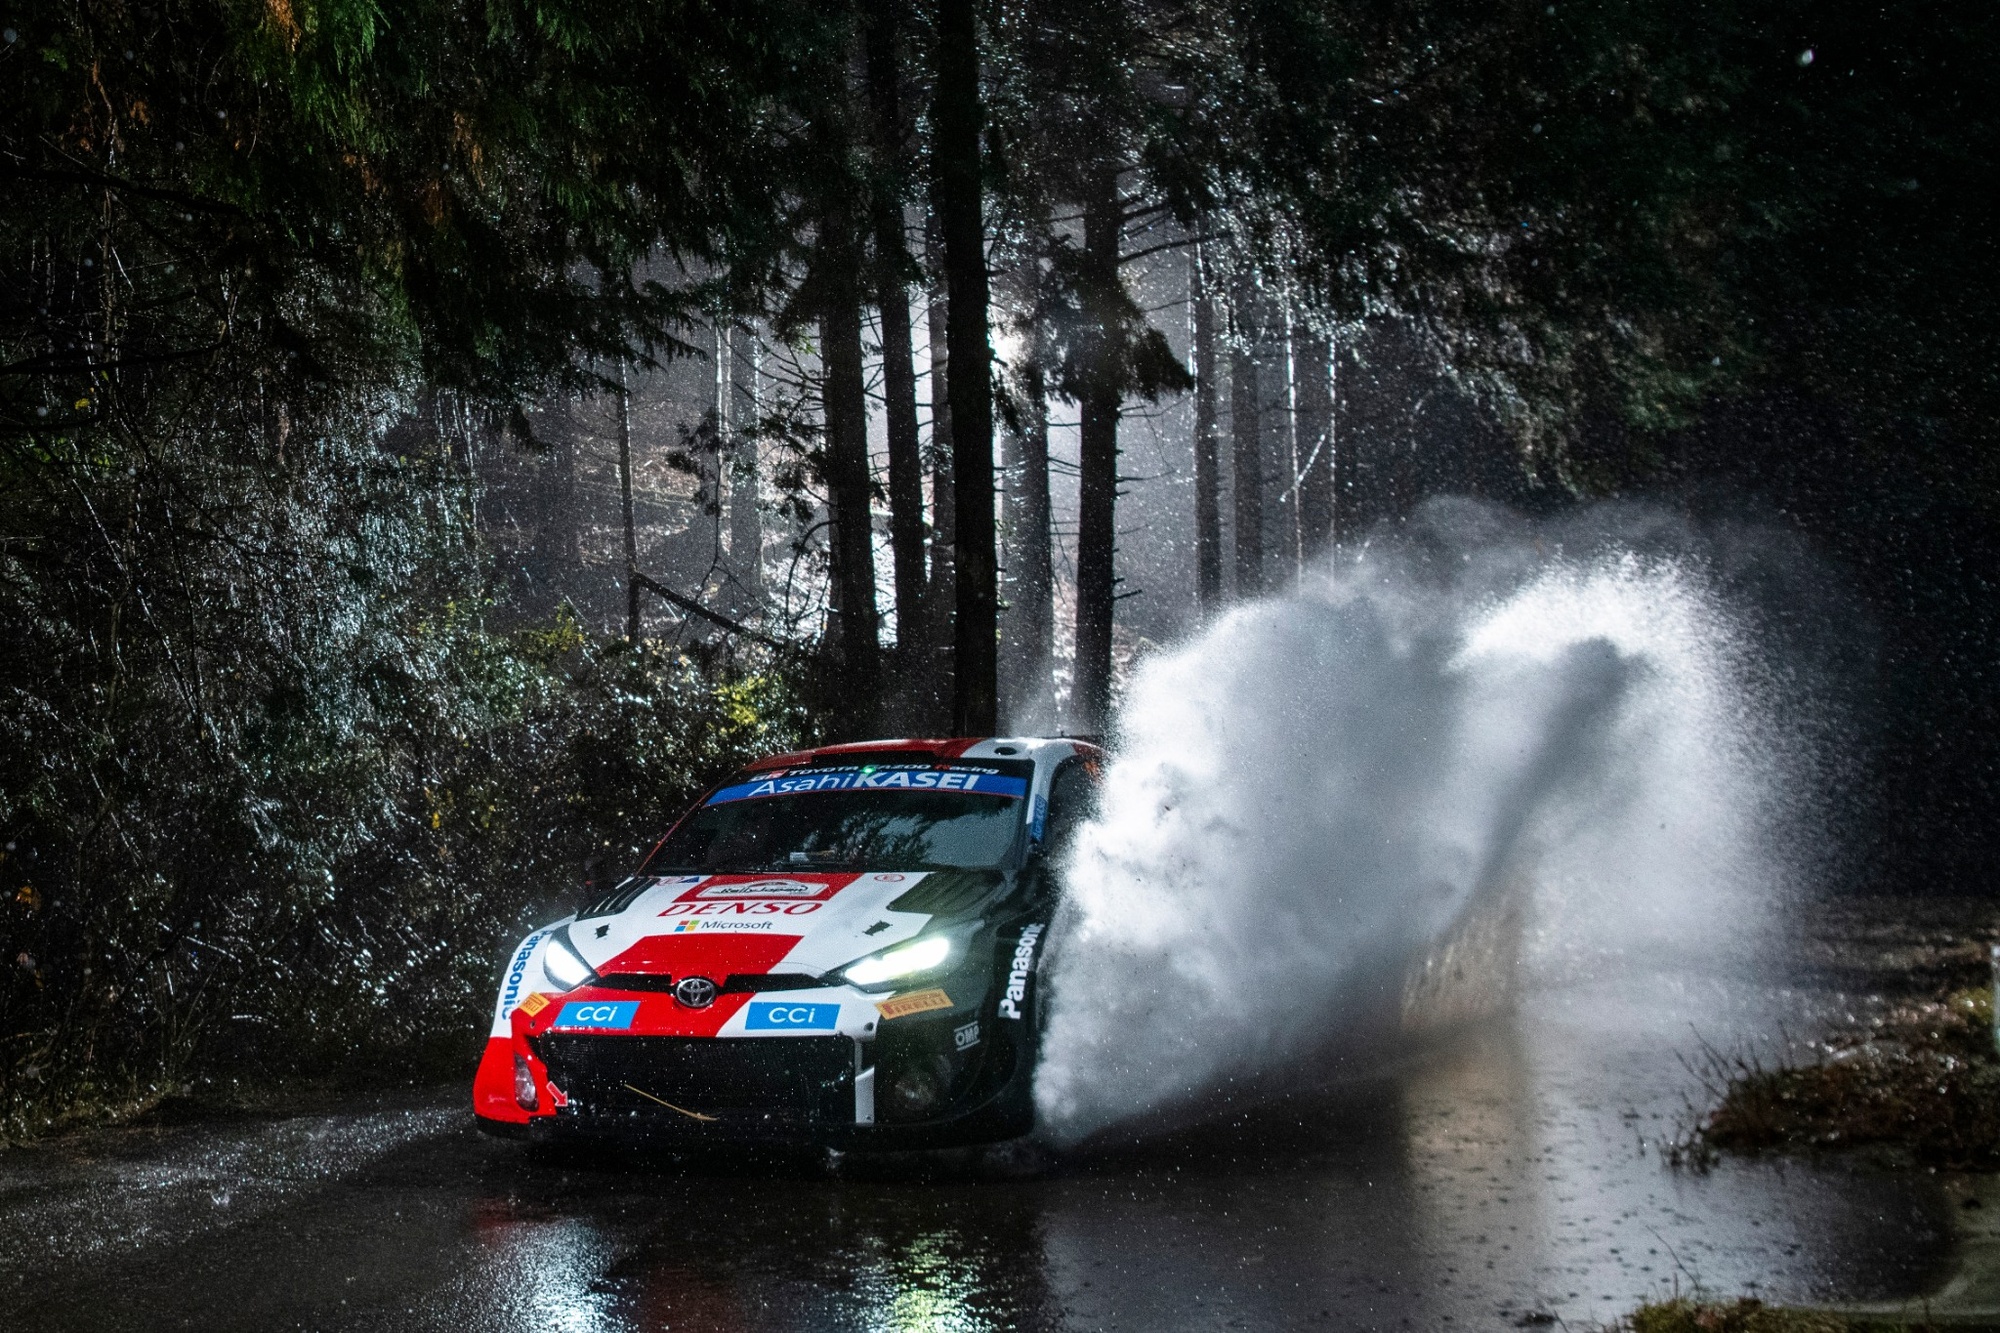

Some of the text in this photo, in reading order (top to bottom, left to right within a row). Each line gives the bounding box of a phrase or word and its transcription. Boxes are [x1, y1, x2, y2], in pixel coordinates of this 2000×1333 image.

[789, 765, 859, 777] TOYOTA
[933, 764, 1000, 775] Racing
[657, 902, 823, 917] DENSO
[700, 919, 773, 931] Microsoft
[501, 930, 554, 1020] Panasonic
[881, 992, 947, 1015] PIRELLI
[955, 1024, 980, 1047] OMP
